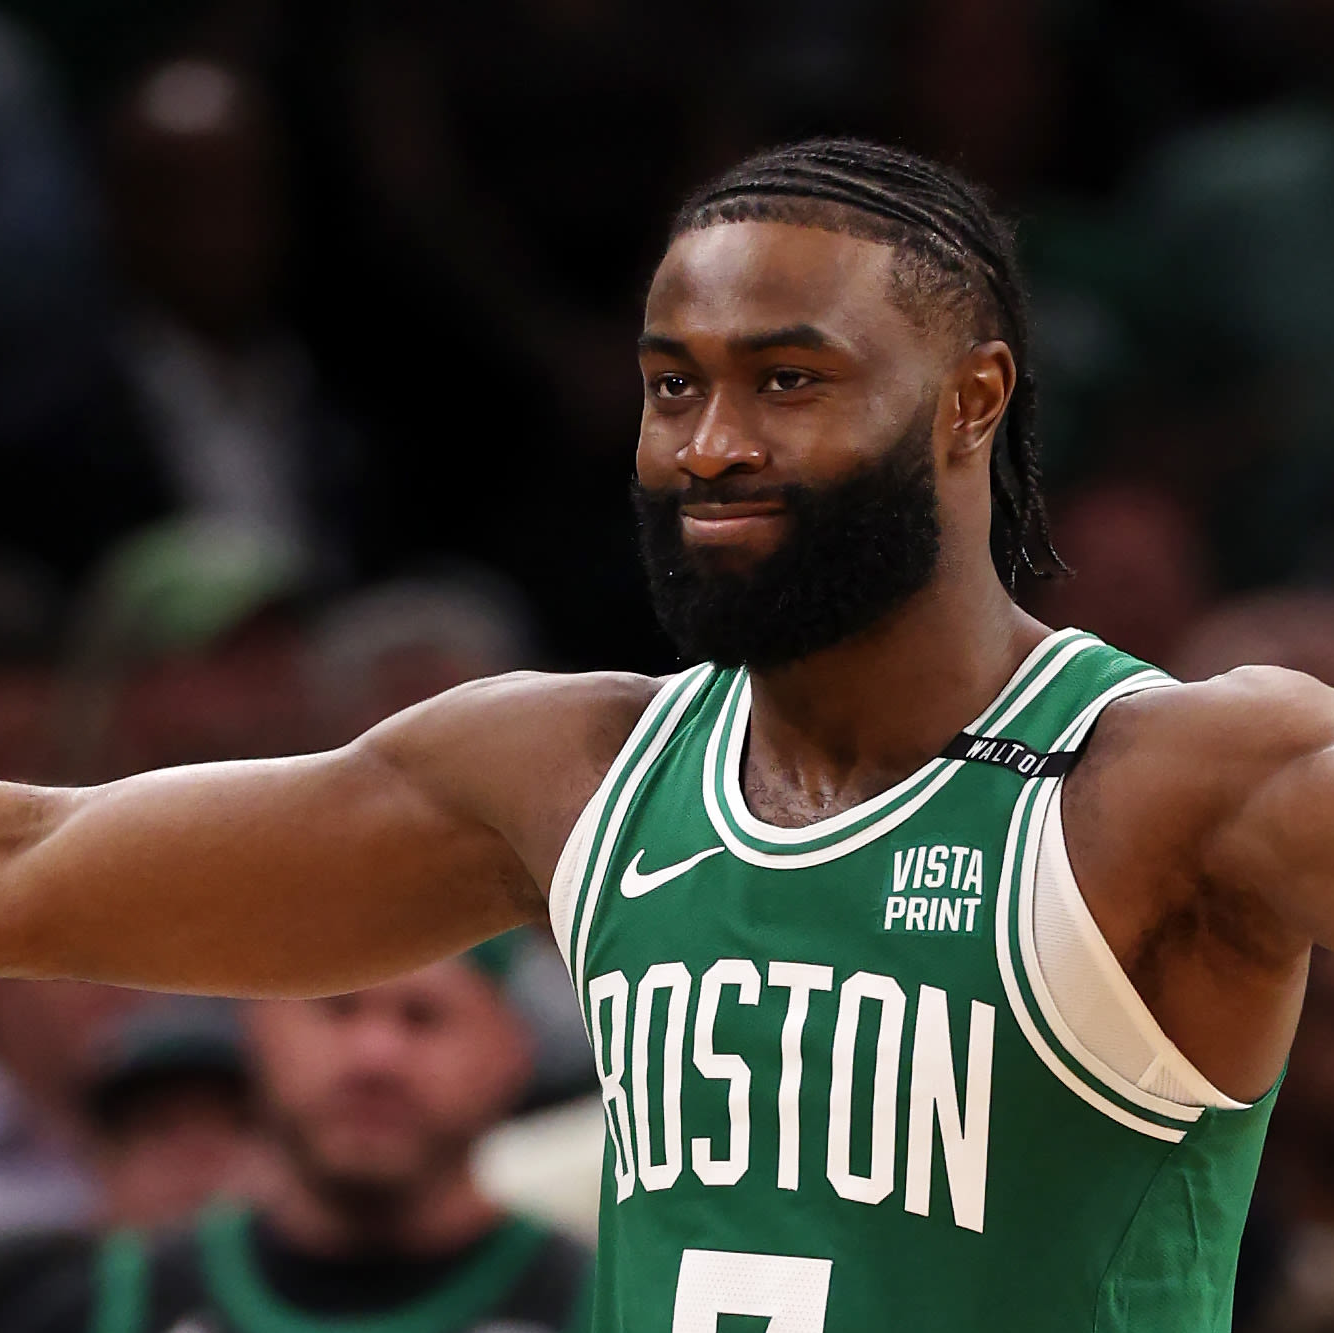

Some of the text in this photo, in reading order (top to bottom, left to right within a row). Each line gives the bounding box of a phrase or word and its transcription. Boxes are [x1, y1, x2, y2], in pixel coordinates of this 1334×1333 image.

[892, 844, 984, 896] VISTA
[883, 895, 982, 933] PRINT
[588, 958, 996, 1234] BOSTON
